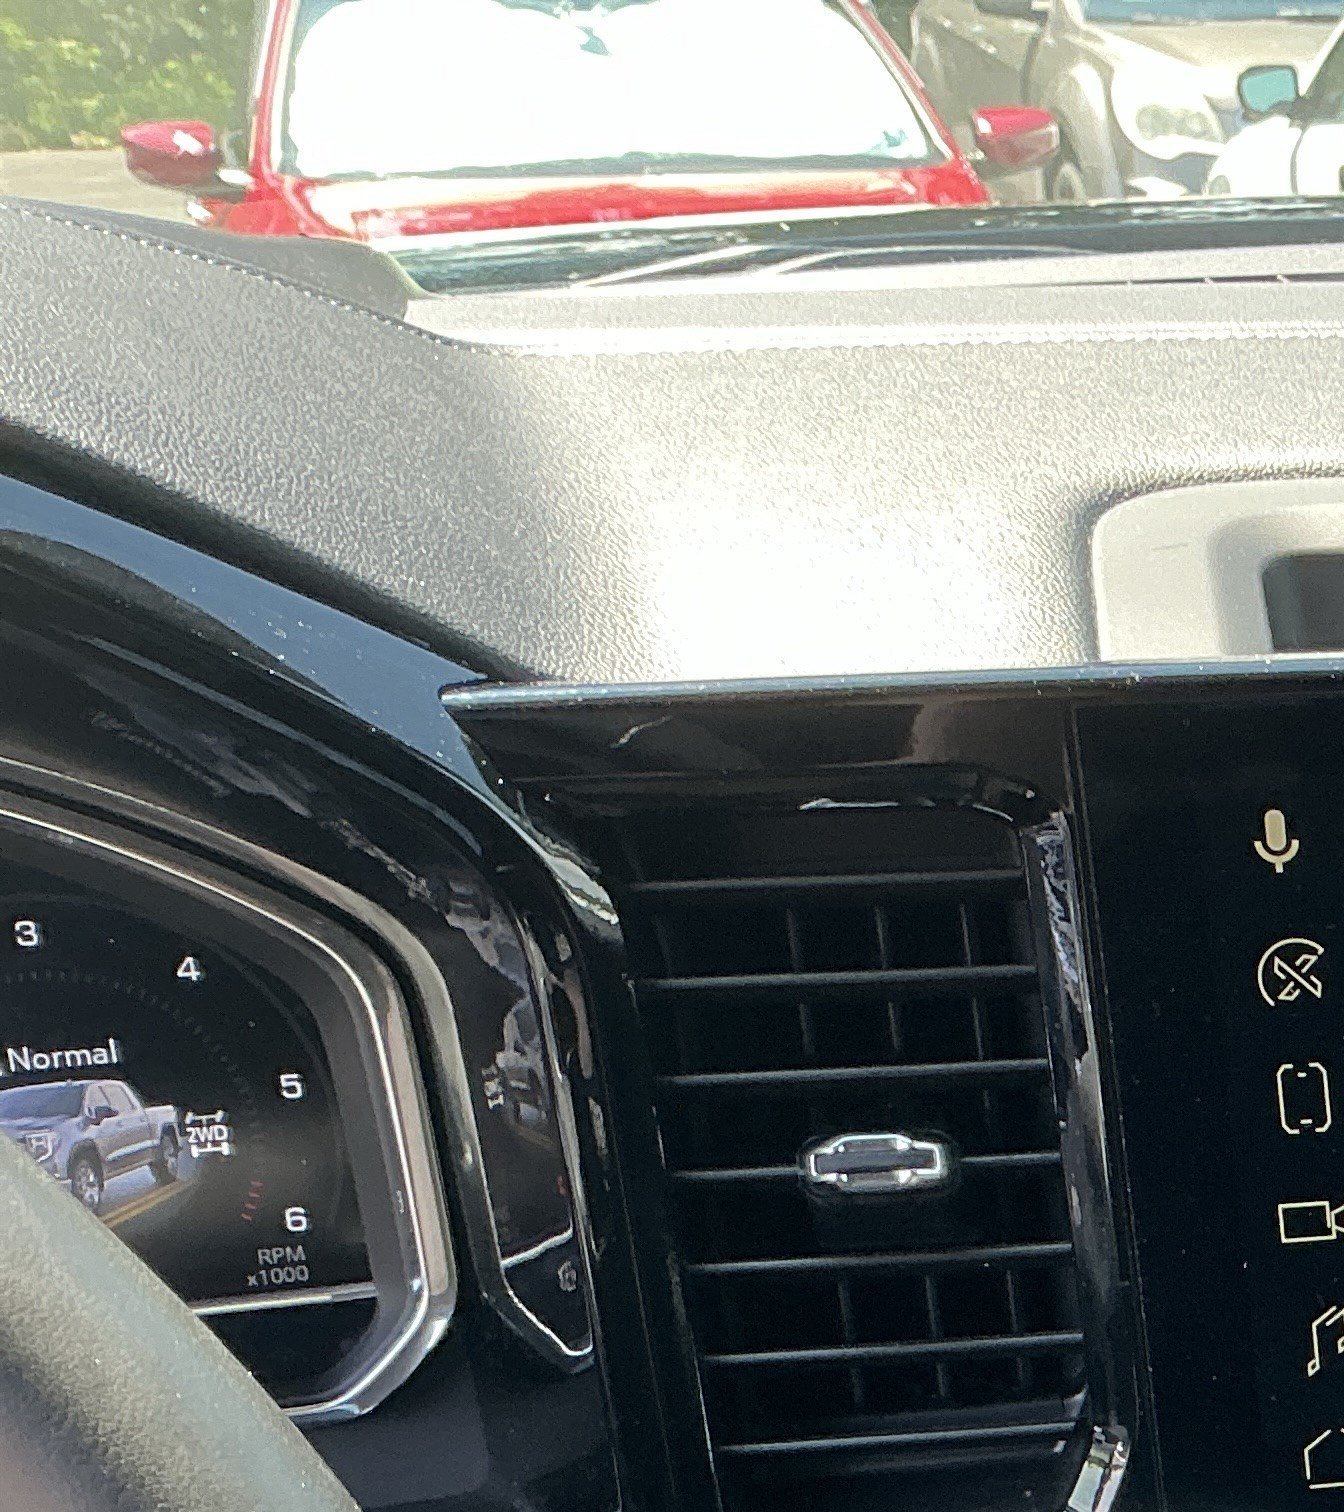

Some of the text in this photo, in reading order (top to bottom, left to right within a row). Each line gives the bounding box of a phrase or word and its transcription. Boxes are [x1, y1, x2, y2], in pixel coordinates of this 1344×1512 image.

[14, 921, 39, 947] 3
[177, 957, 201, 981] 4
[7, 1038, 118, 1072] Normal
[280, 1074, 303, 1098] 5
[186, 1125, 228, 1142] 2WD
[285, 1207, 308, 1231] 6
[257, 1246, 306, 1263] RPM
[247, 1265, 309, 1286] x1000
